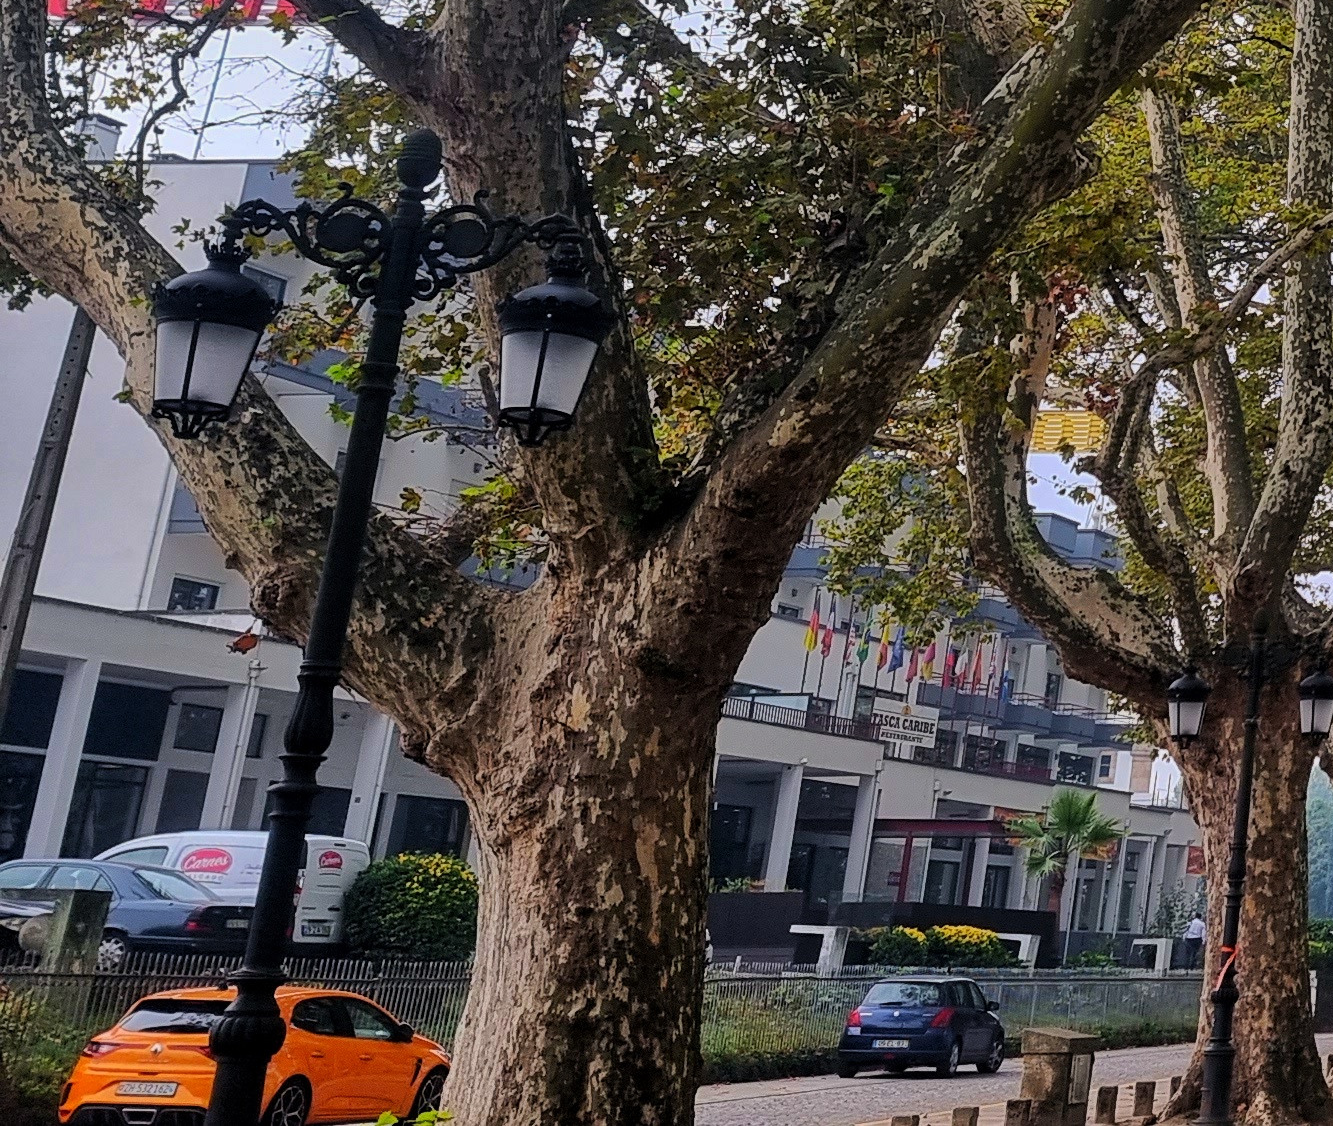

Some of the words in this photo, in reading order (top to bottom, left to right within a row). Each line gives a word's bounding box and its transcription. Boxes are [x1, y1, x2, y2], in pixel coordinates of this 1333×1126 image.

[871, 713, 900, 729] TASCA
[902, 719, 935, 734] CARIBE
[183, 855, 229, 870] Carnes
